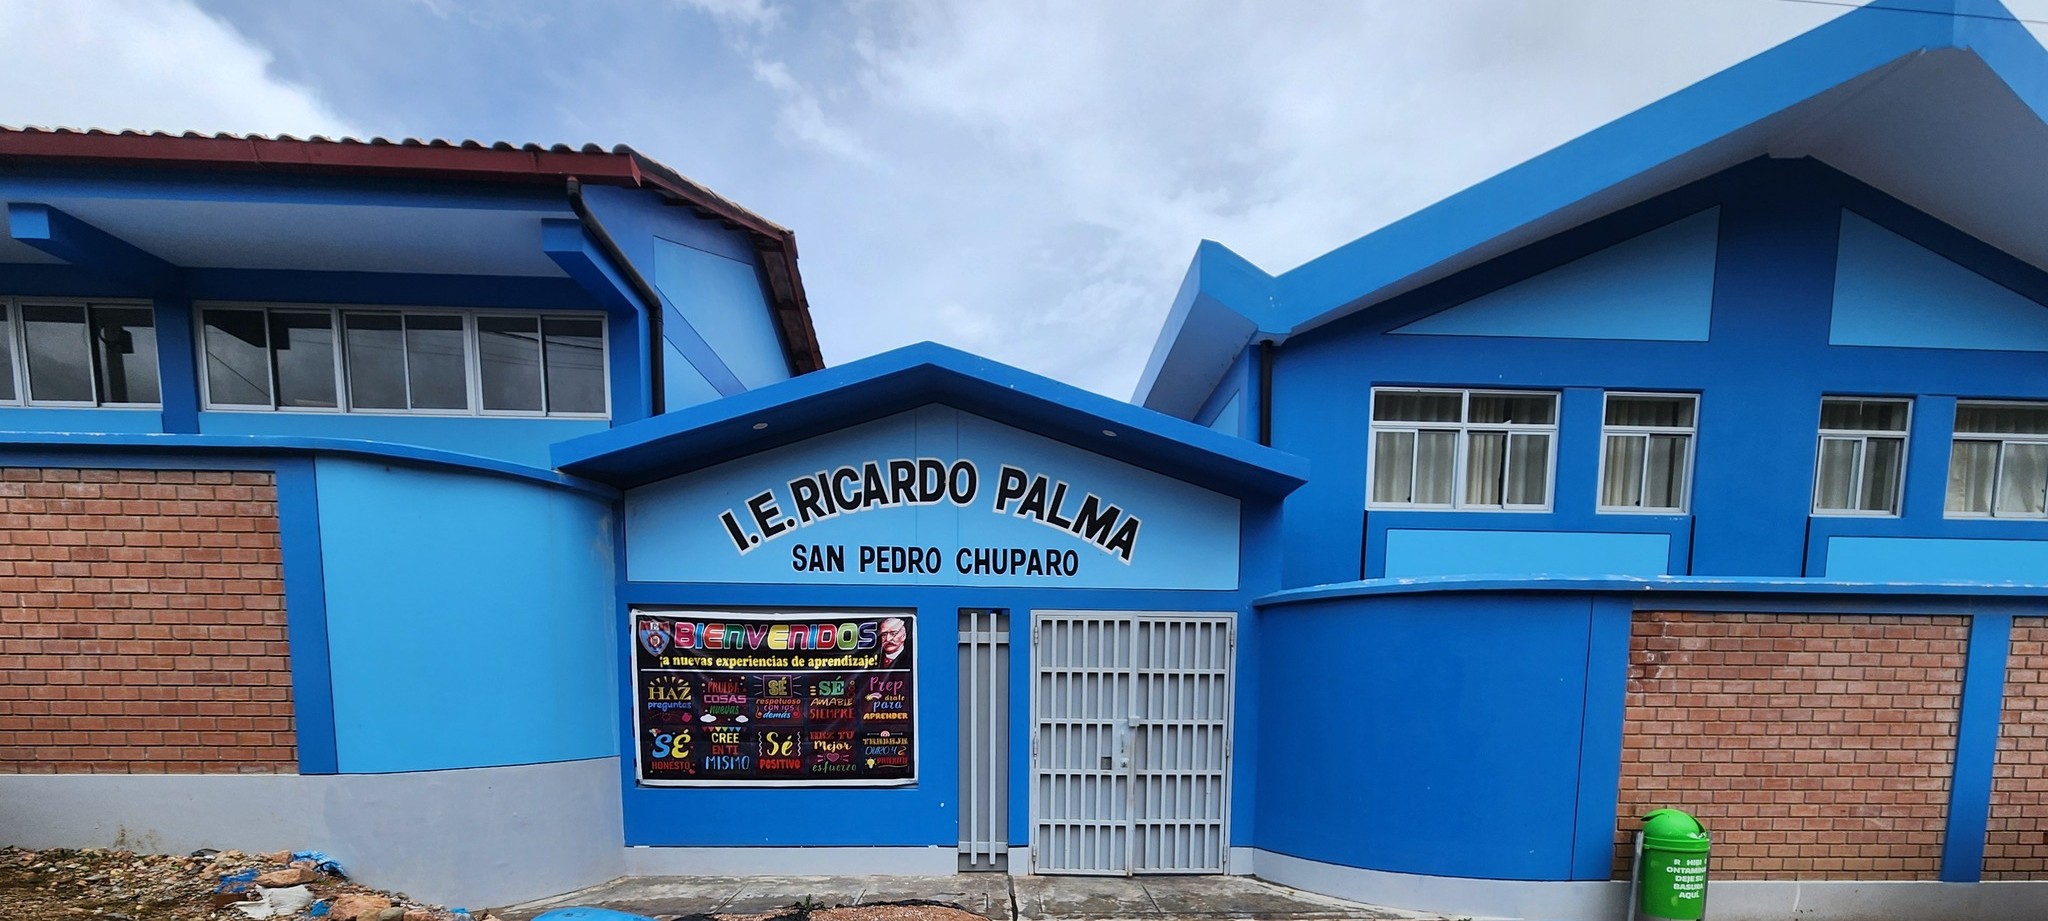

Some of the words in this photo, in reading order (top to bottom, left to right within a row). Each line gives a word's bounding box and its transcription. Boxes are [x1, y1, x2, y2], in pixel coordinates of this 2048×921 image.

[788, 458, 979, 527] RICARDO
[993, 464, 1142, 566] PALMA
[792, 544, 845, 573] SAN
[859, 545, 942, 575] PEDRO
[956, 547, 1080, 577] CHUPARO
[674, 621, 877, 650] BIENVENIDOS
[672, 656, 713, 667] nuevas
[716, 656, 789, 669] experiencias
[791, 655, 805, 667] de
[808, 654, 878, 669] aprendizaje!
[768, 676, 788, 696] SÉ
[818, 675, 844, 696] SÉ
[648, 686, 692, 700] HAZ
[703, 694, 747, 704] COSAS
[809, 697, 853, 707] AMABLE
[647, 701, 692, 712] preguntas
[709, 705, 740, 715] nuevas
[873, 700, 903, 712] para
[762, 710, 791, 719] demás
[809, 708, 855, 719] SIEMPRE
[863, 712, 909, 720] APRENDER
[711, 732, 740, 743] CREE
[652, 728, 691, 759] SÉ
[814, 740, 852, 753] Mejor
[712, 745, 724, 755] EN
[725, 745, 738, 755] TI
[651, 761, 690, 770] HONESTO
[705, 755, 750, 770] MISMO
[759, 759, 801, 769] POSITIVO
[1675, 875, 1695, 883] DEJE
